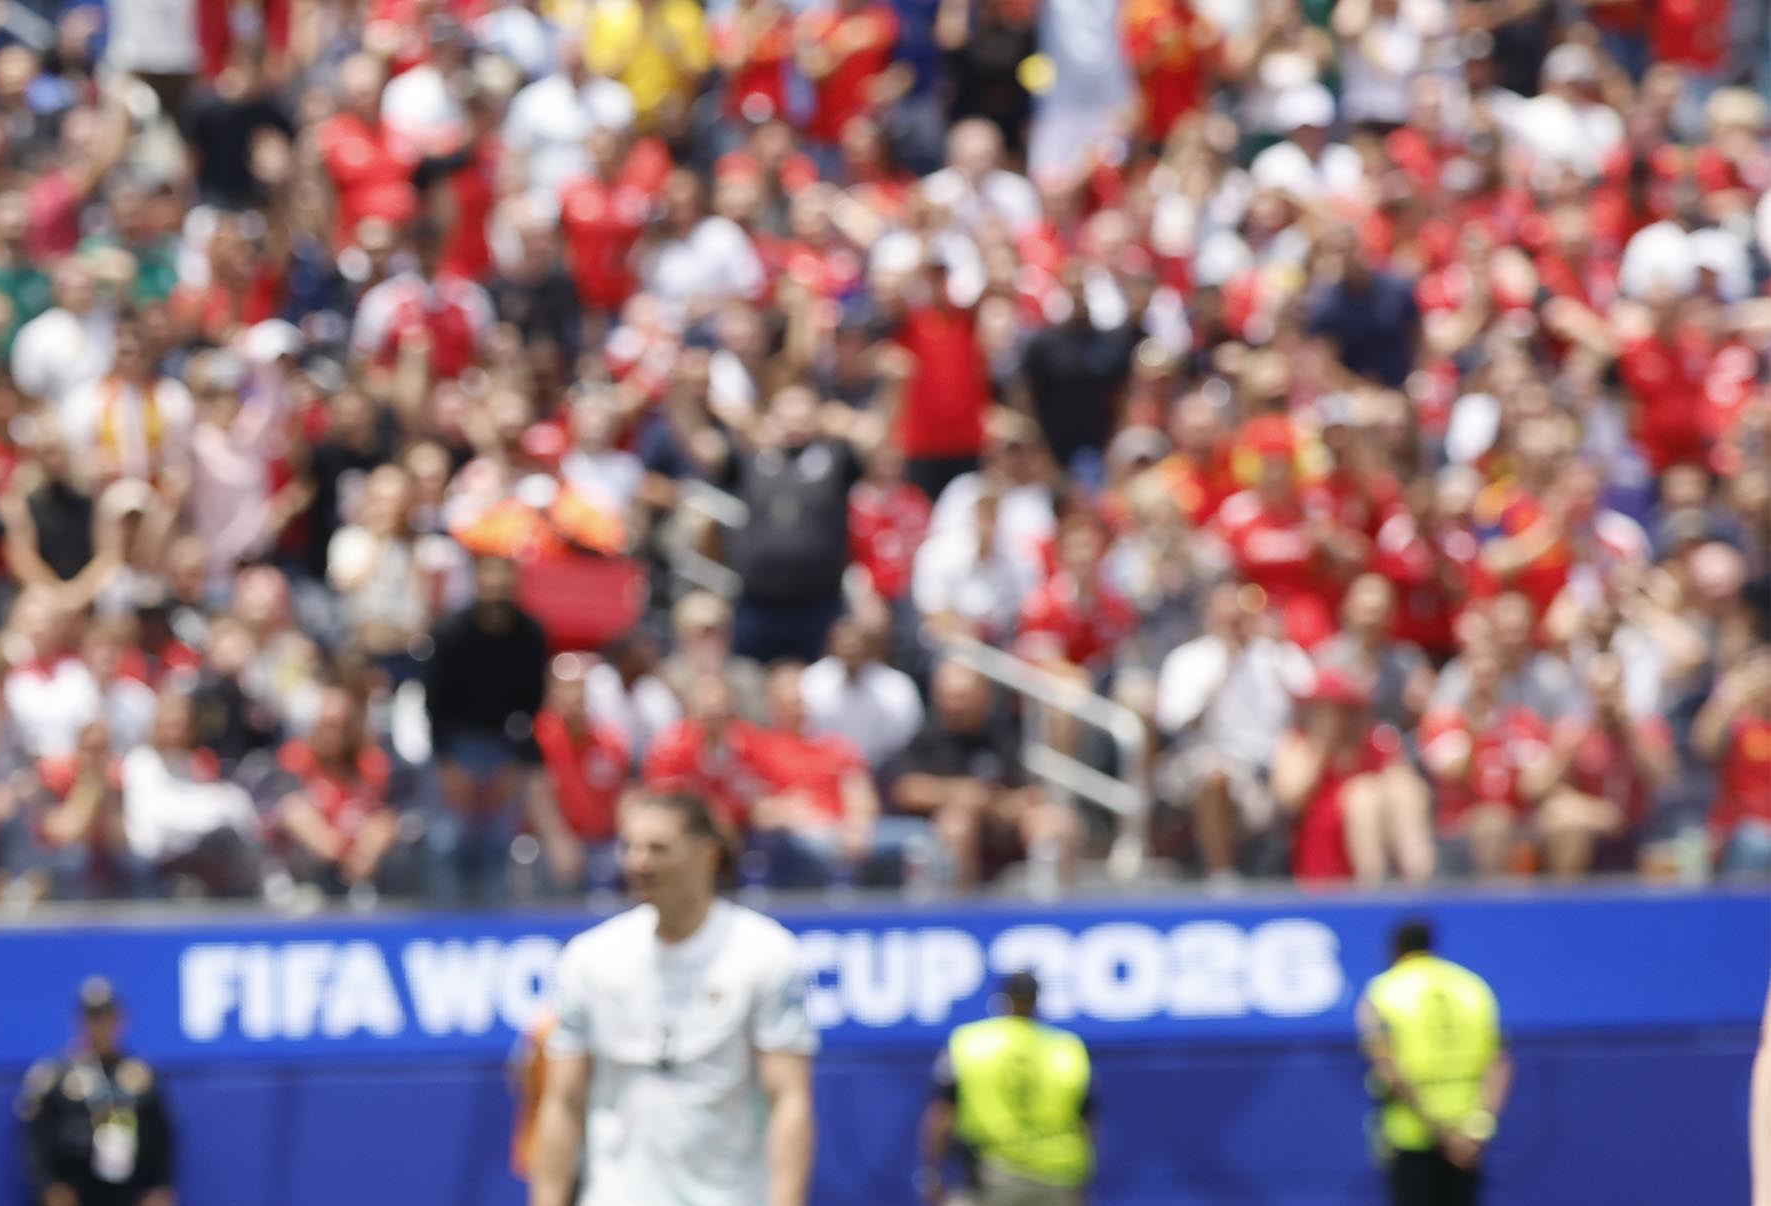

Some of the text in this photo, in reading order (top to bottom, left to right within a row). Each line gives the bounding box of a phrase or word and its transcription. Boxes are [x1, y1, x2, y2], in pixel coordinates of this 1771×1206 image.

[179, 940, 406, 1042] FIFA
[797, 929, 985, 1027] CUP
[989, 917, 1344, 1022] 2026
